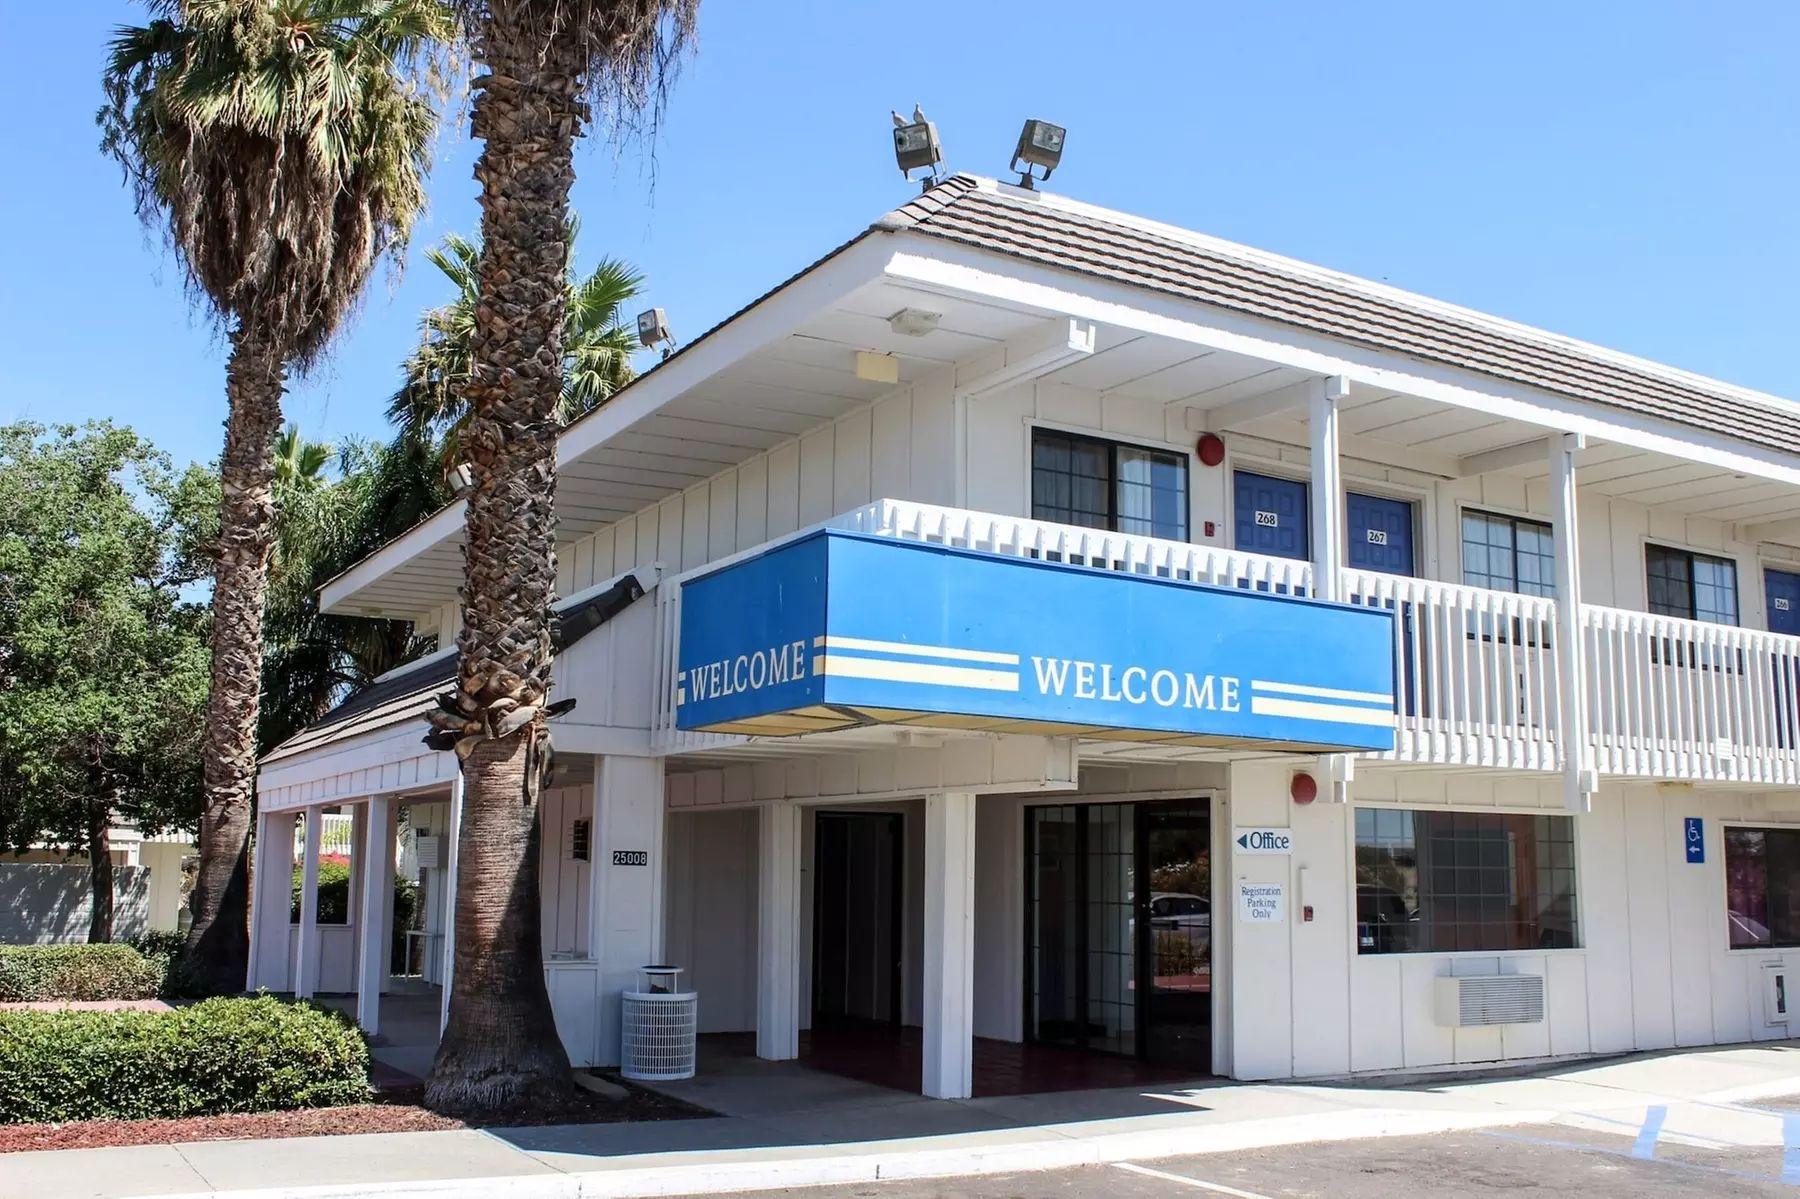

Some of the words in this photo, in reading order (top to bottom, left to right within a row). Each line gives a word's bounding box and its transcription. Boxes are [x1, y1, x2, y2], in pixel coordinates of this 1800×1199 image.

[1257, 513, 1276, 525] 268
[1369, 531, 1385, 543] 267
[691, 640, 805, 702] WELCOME
[1031, 656, 1240, 713] WELCOME
[1250, 831, 1289, 849] Office
[614, 852, 647, 865] 25008
[1241, 886, 1282, 898] Registration
[1247, 898, 1276, 909] Parking
[1252, 908, 1271, 919] Only
